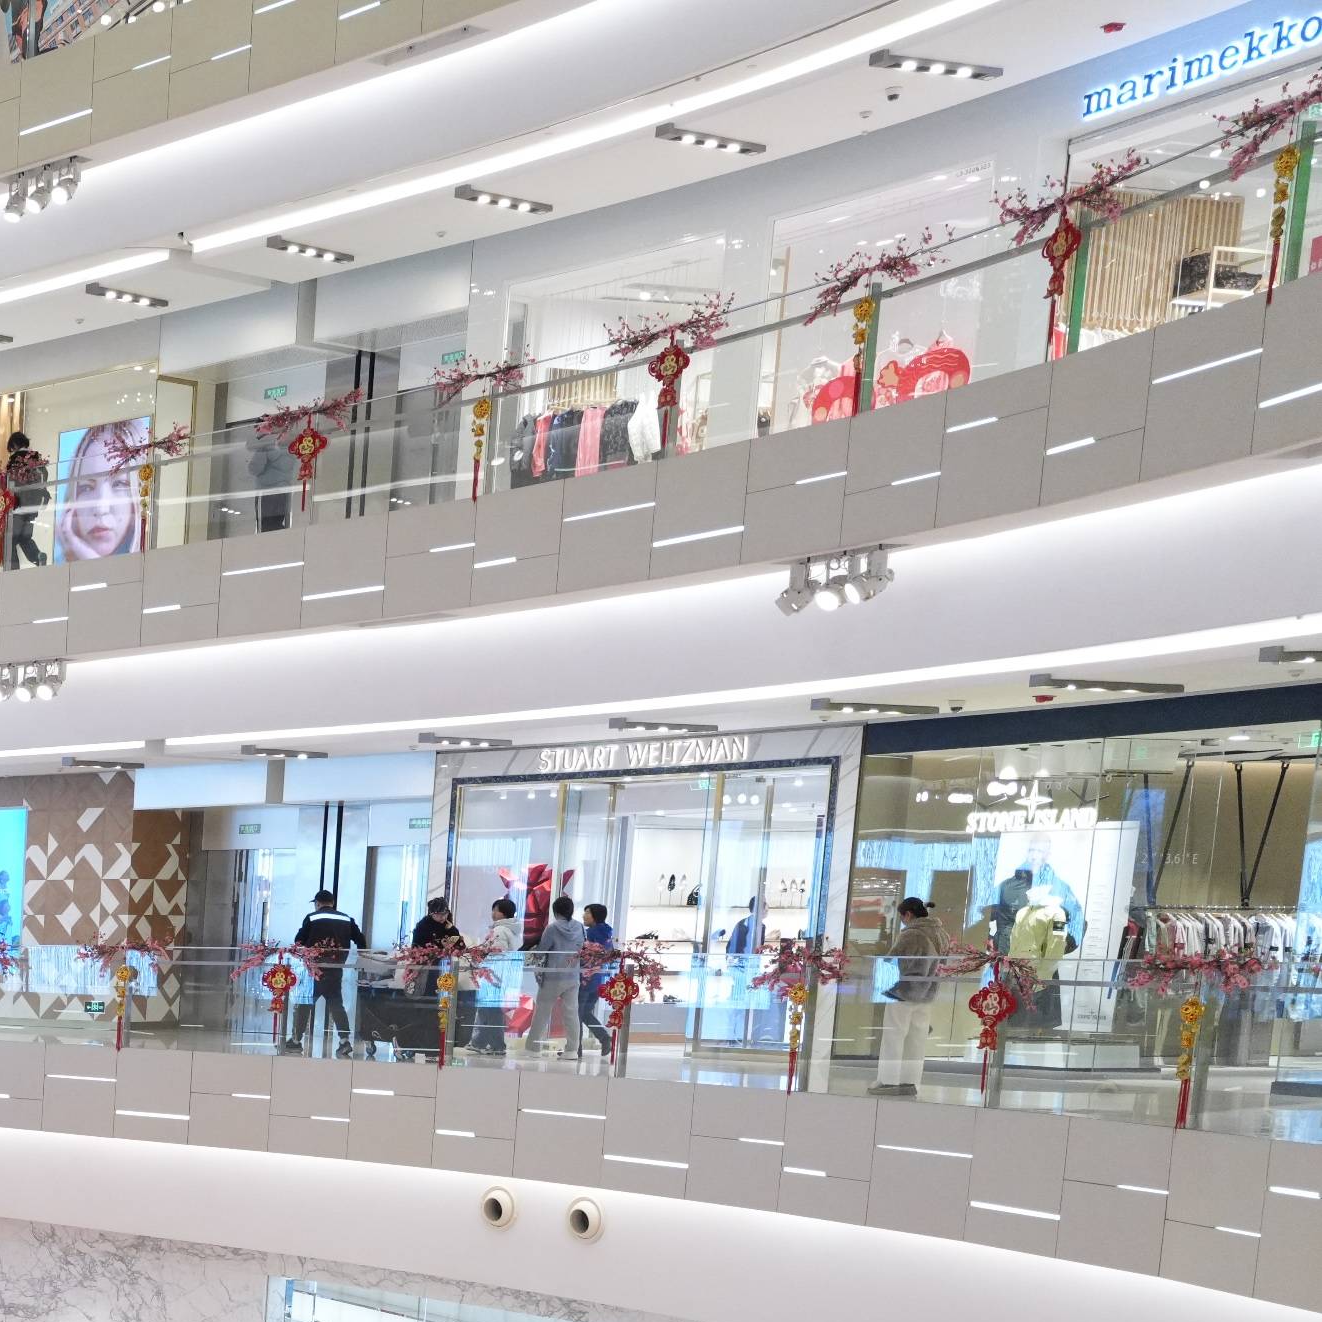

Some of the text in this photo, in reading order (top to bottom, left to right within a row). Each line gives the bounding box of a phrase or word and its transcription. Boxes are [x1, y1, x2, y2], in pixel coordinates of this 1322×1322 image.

[1082, 15, 1322, 118] marimekko
[538, 736, 749, 773] STUART WEITZMAN
[966, 807, 1098, 832] STONE ISLAND
